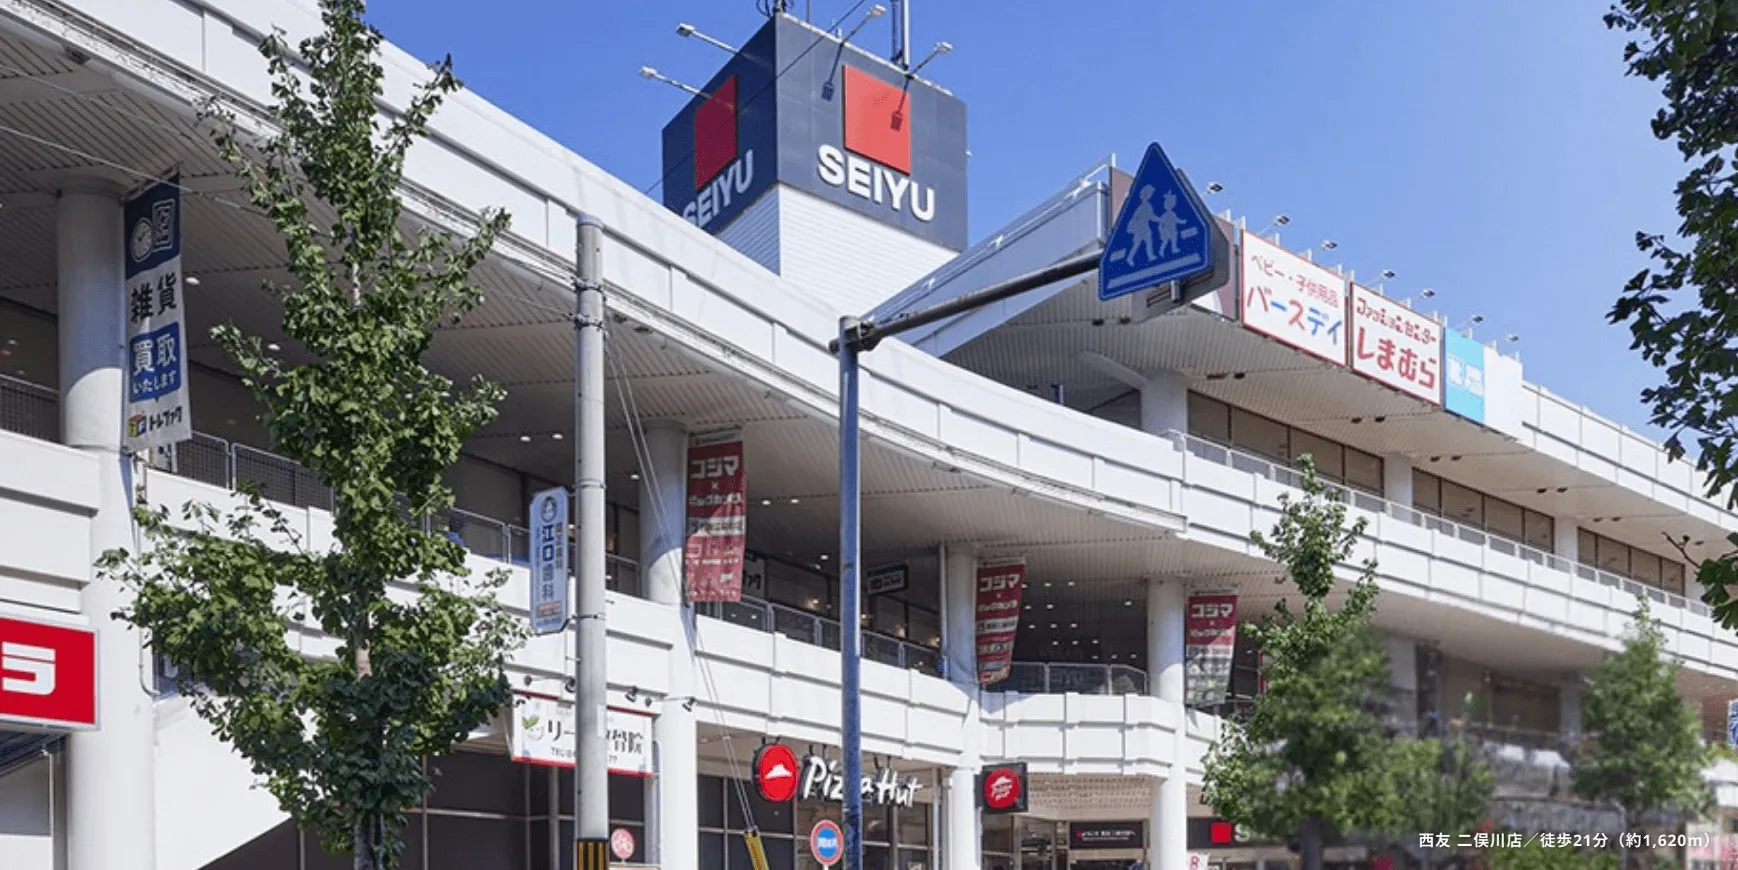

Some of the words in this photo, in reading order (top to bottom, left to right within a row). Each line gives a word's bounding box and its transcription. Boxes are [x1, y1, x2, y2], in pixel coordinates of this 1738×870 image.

[683, 149, 753, 228] SEIYU
[818, 145, 935, 221] SEIYU
[130, 272, 177, 324] 雑貨
[132, 333, 177, 377] 買取
[1358, 327, 1437, 388] しまむら
[132, 370, 177, 394] いたします
[690, 456, 740, 479] コジマ
[980, 573, 1021, 592] コジマ
[1191, 603, 1234, 618] コジマ
[1, 641, 56, 695] ラ
[803, 756, 875, 799] Piza
[875, 767, 923, 808] Hut
